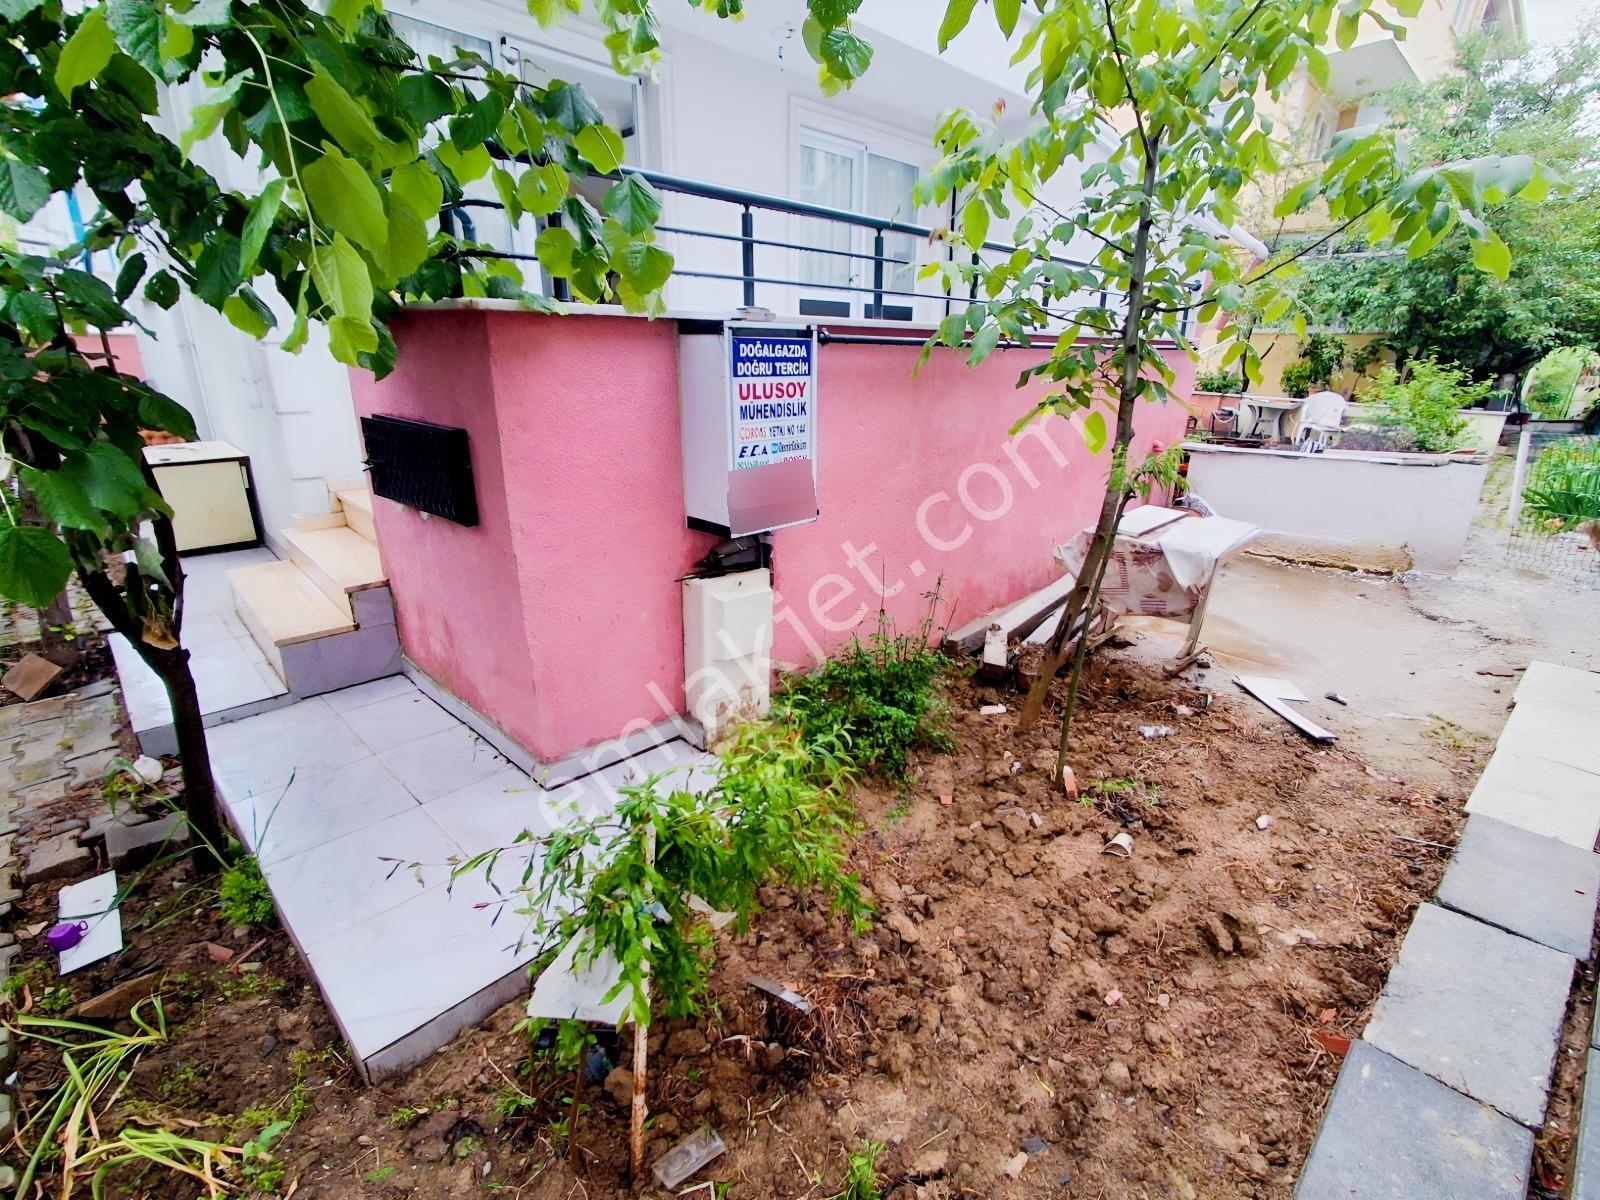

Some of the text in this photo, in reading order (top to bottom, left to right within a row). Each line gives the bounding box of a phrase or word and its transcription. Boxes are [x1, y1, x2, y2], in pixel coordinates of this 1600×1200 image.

[739, 341, 808, 358] DOĞALGAZDA
[737, 359, 809, 376] DOĞRU TERCİH
[739, 381, 807, 401] ULUSOY
[740, 399, 807, 420] MÜHENDİSLİK
